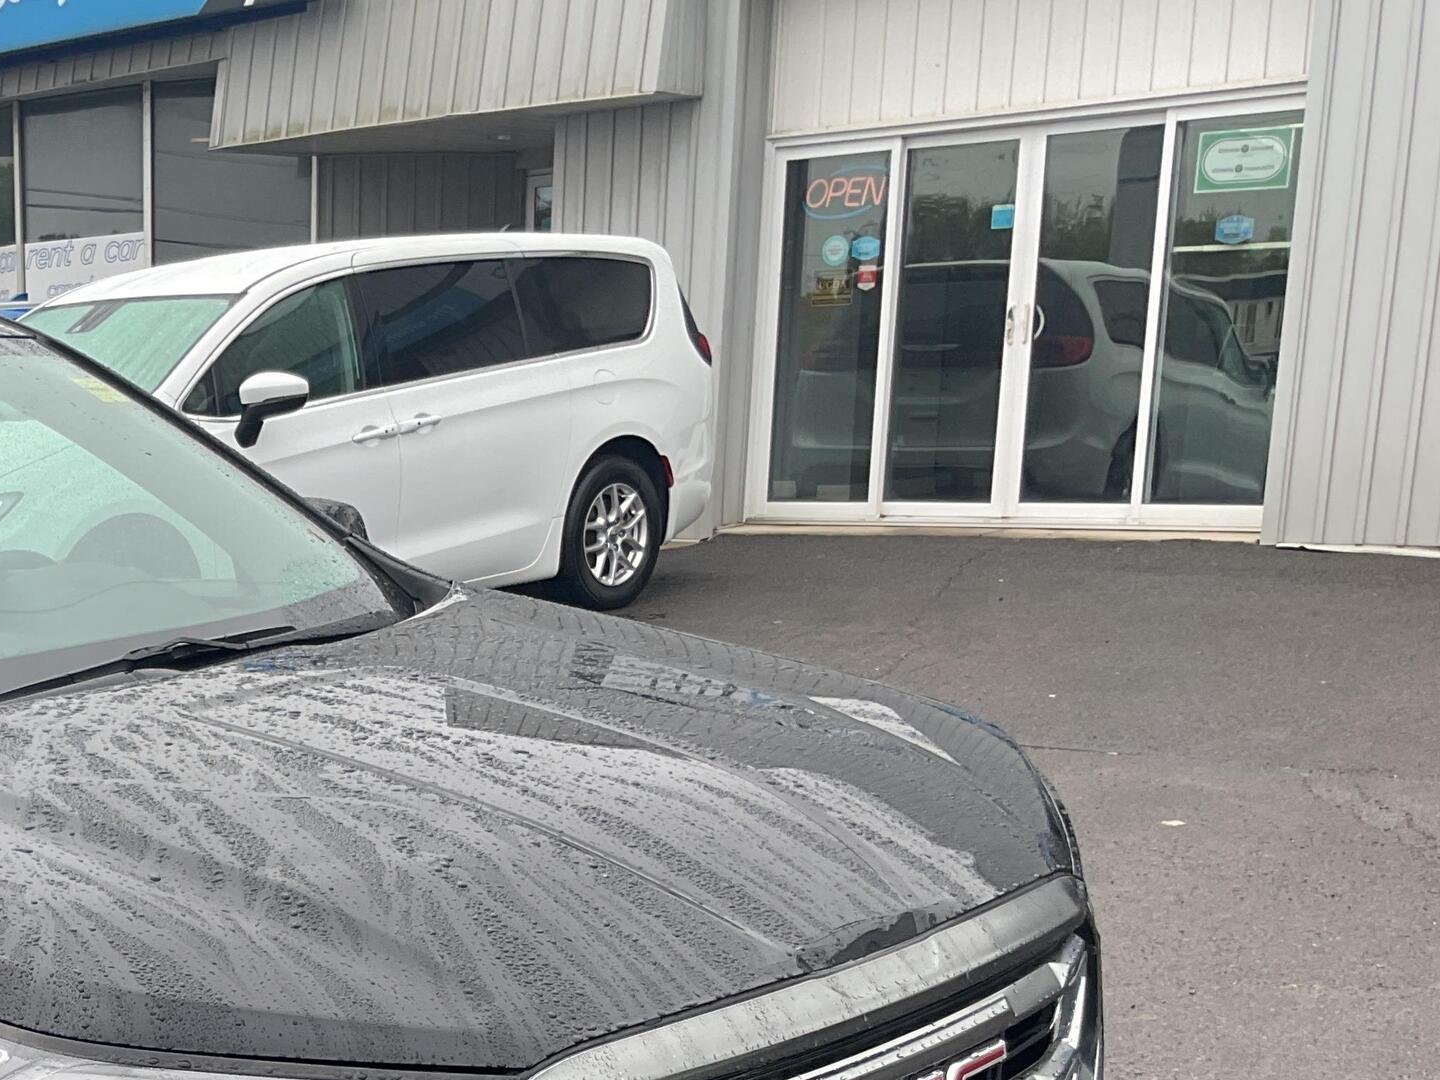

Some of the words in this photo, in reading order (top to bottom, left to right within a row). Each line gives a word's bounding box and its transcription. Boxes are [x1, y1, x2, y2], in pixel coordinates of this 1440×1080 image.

[805, 176, 887, 208] OPEN
[25, 239, 74, 270] rent
[80, 242, 97, 266] a
[104, 238, 145, 263] car
